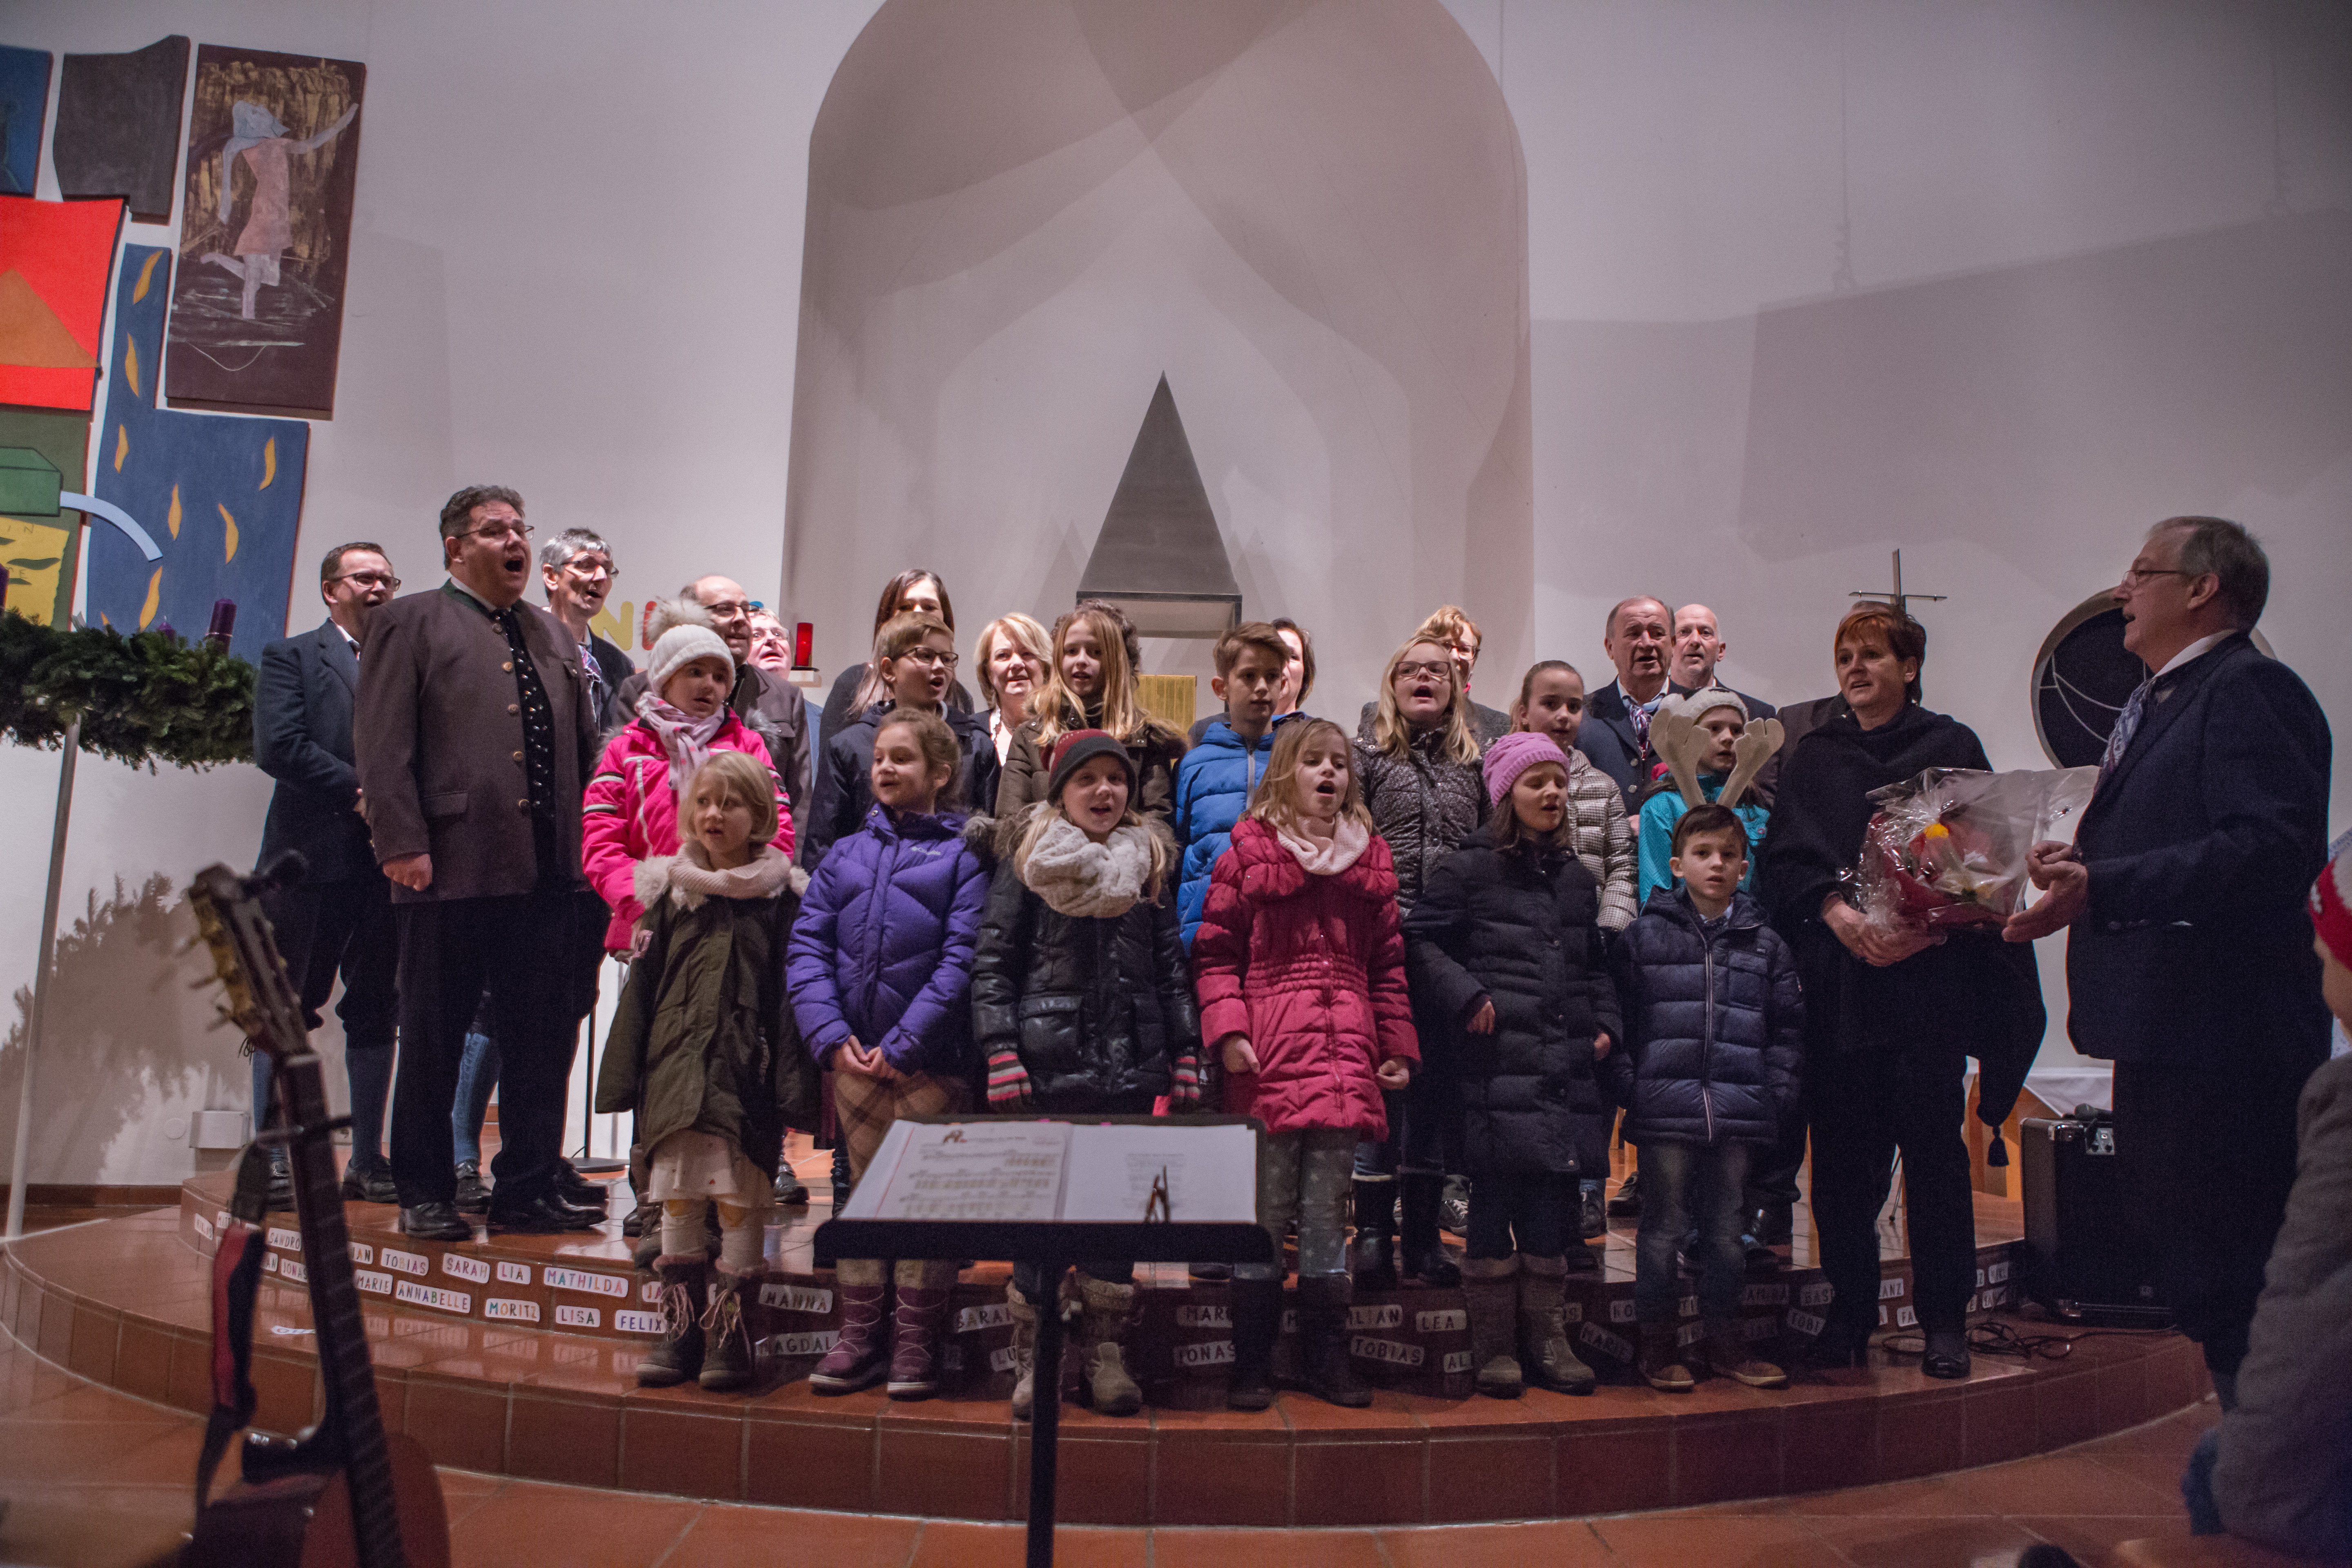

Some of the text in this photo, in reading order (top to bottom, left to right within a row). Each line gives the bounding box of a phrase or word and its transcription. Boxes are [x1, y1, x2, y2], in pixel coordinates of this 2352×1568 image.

[270, 1232, 301, 1250] SANDRO
[283, 1261, 307, 1280] JONAS
[386, 1254, 426, 1274] TOBIAS
[447, 1257, 488, 1278] SARAH
[502, 1264, 523, 1281] LIA
[356, 1275, 389, 1293] MARIE
[547, 1270, 623, 1294] MATHILDA
[1879, 1283, 1902, 1298] ANZ
[398, 1284, 468, 1310] ANNABELLE
[764, 1291, 827, 1312] HANNA
[489, 1302, 537, 1319] MORITZ
[561, 1308, 595, 1325] LISA
[620, 1315, 662, 1332] FELIX
[1421, 1316, 1454, 1330] LEA
[1355, 1339, 1421, 1363] TOBIAS
